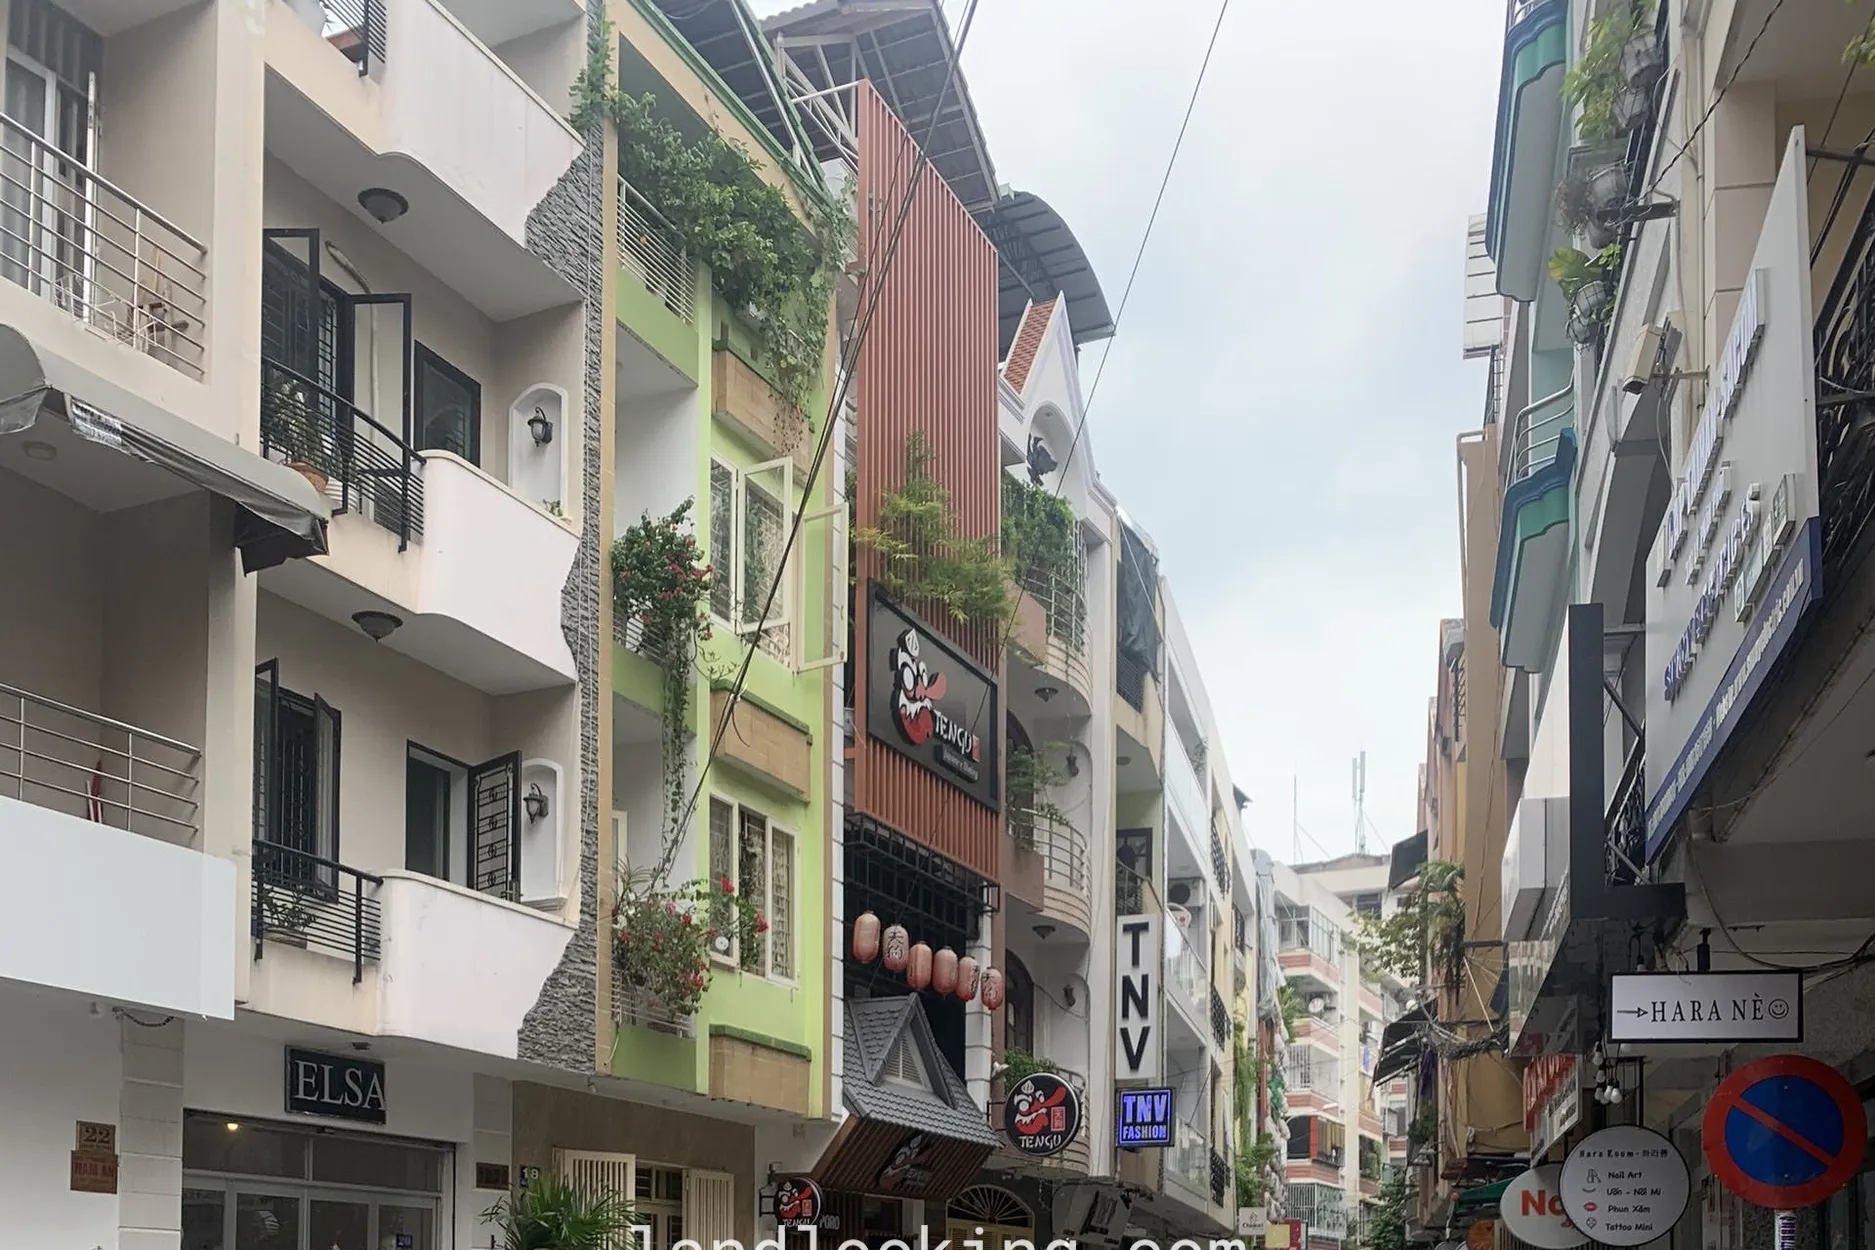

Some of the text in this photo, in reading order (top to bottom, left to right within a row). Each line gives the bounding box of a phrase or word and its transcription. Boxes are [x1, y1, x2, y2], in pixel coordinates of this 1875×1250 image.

[934, 710, 973, 755] TENGU
[1120, 922, 1151, 1071] TNV
[1651, 992, 1764, 1022] HARA NÈ
[294, 1060, 387, 1111] ELSA
[1123, 1094, 1168, 1123] TNV
[84, 1127, 110, 1144] 22
[1123, 1126, 1167, 1140] FASHION
[1018, 1135, 1062, 1148] TENGU
[522, 1168, 539, 1180] 18
[1608, 1171, 1642, 1179] Nail Art
[1608, 1204, 1629, 1212] Phun
[1605, 1223, 1653, 1231] Tattoo Mini
